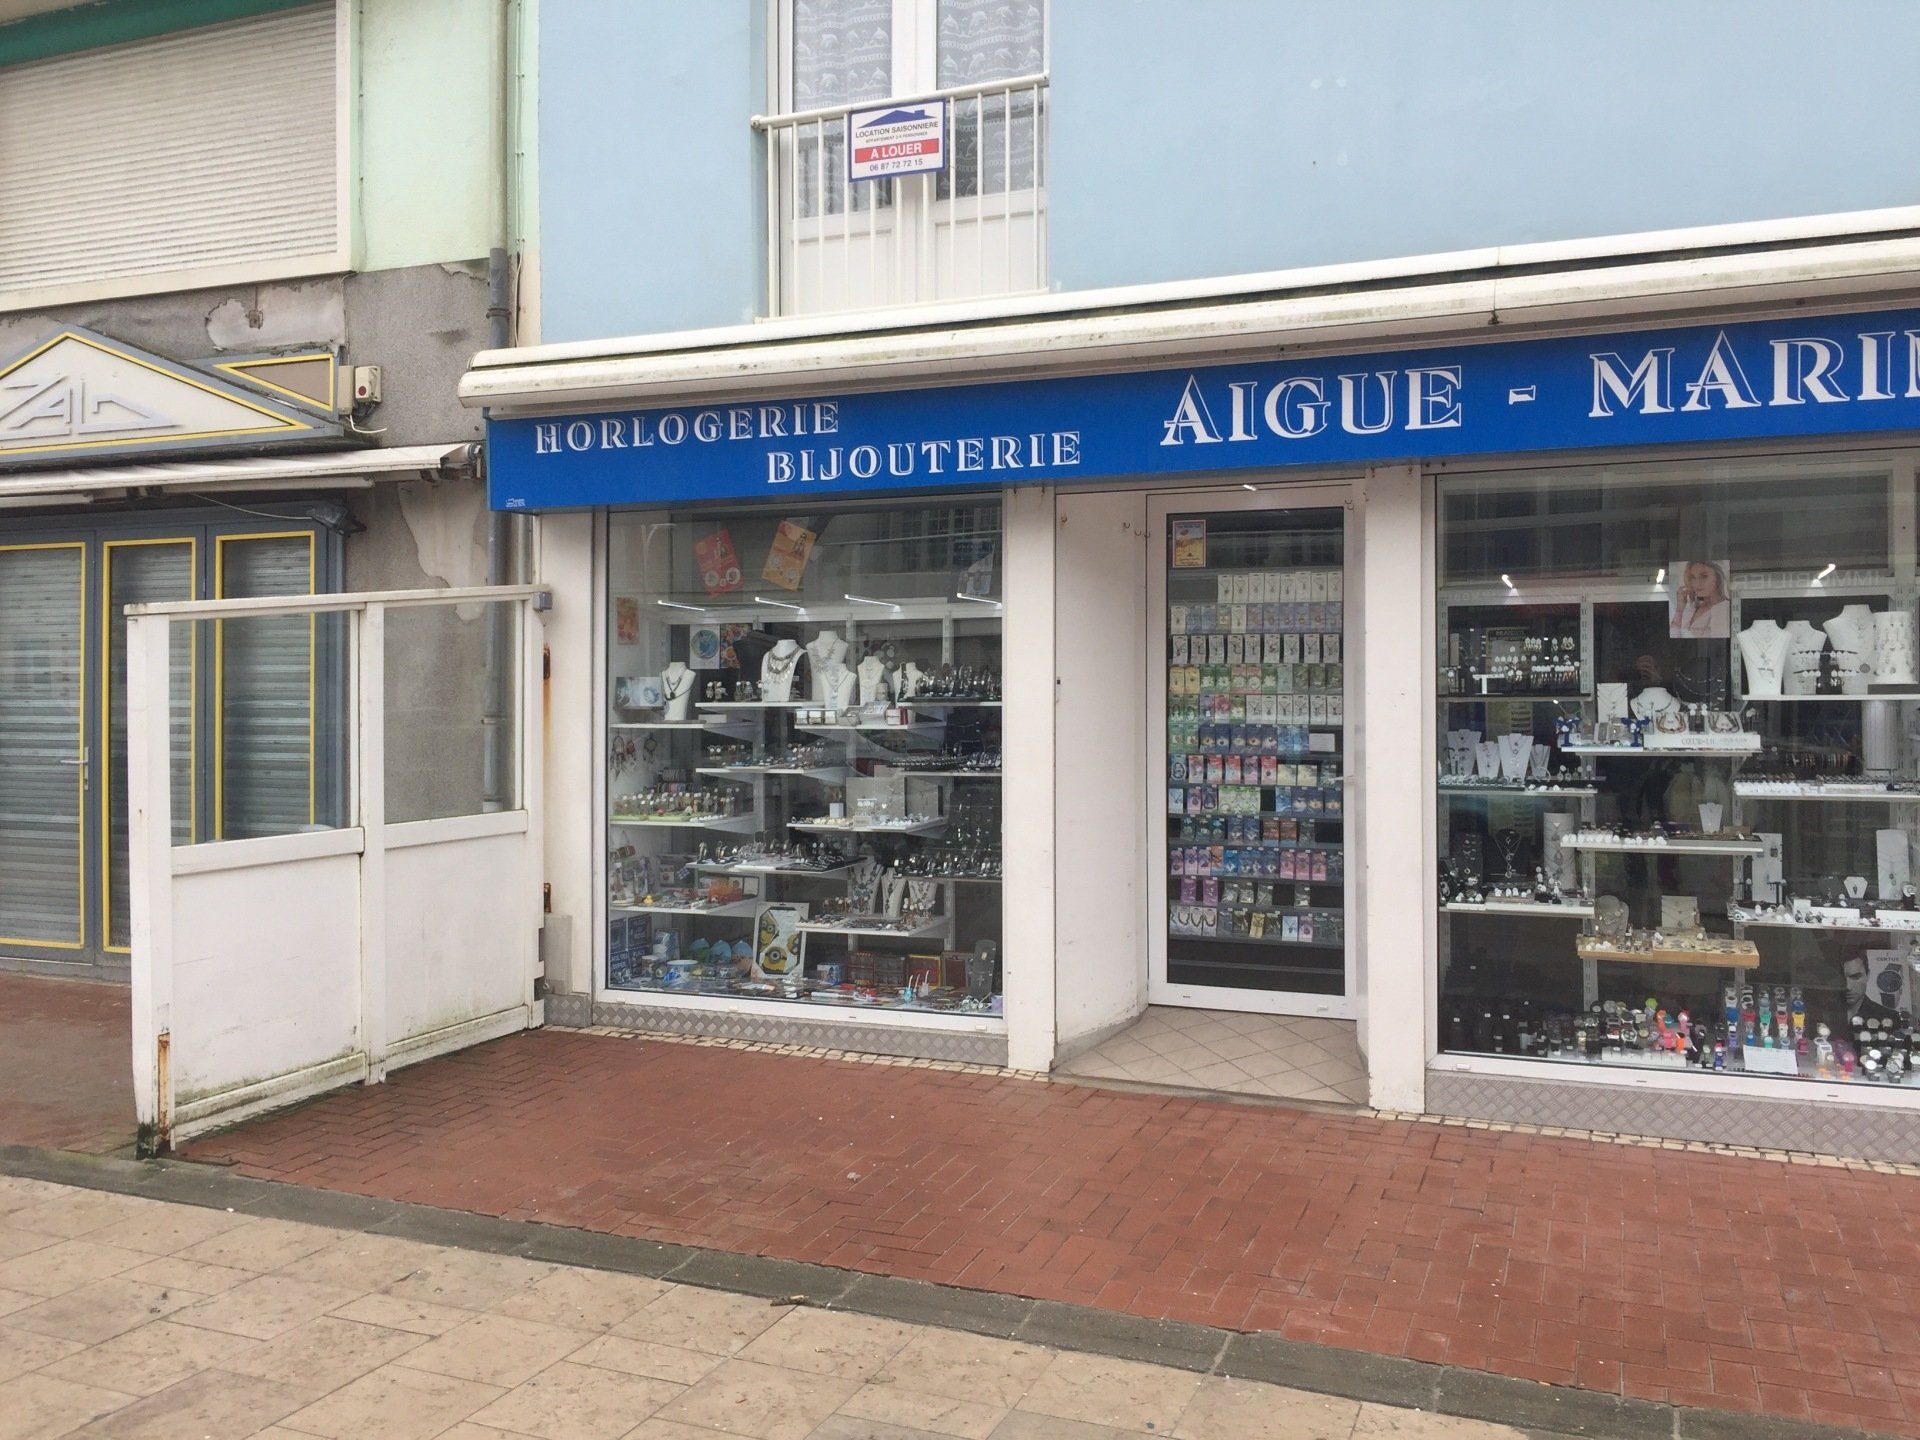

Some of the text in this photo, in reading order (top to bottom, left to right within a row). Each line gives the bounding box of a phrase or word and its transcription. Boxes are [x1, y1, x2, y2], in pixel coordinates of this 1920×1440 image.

[855, 121, 939, 139] LOCATION SAISONNIERE
[869, 158, 923, 172] 06 87 72 72 15
[870, 143, 922, 160] A LOUER
[1159, 365, 1463, 447] AIGUE
[535, 401, 840, 455] HORLOGERIE
[766, 430, 1081, 484] BIJOUTERIE
